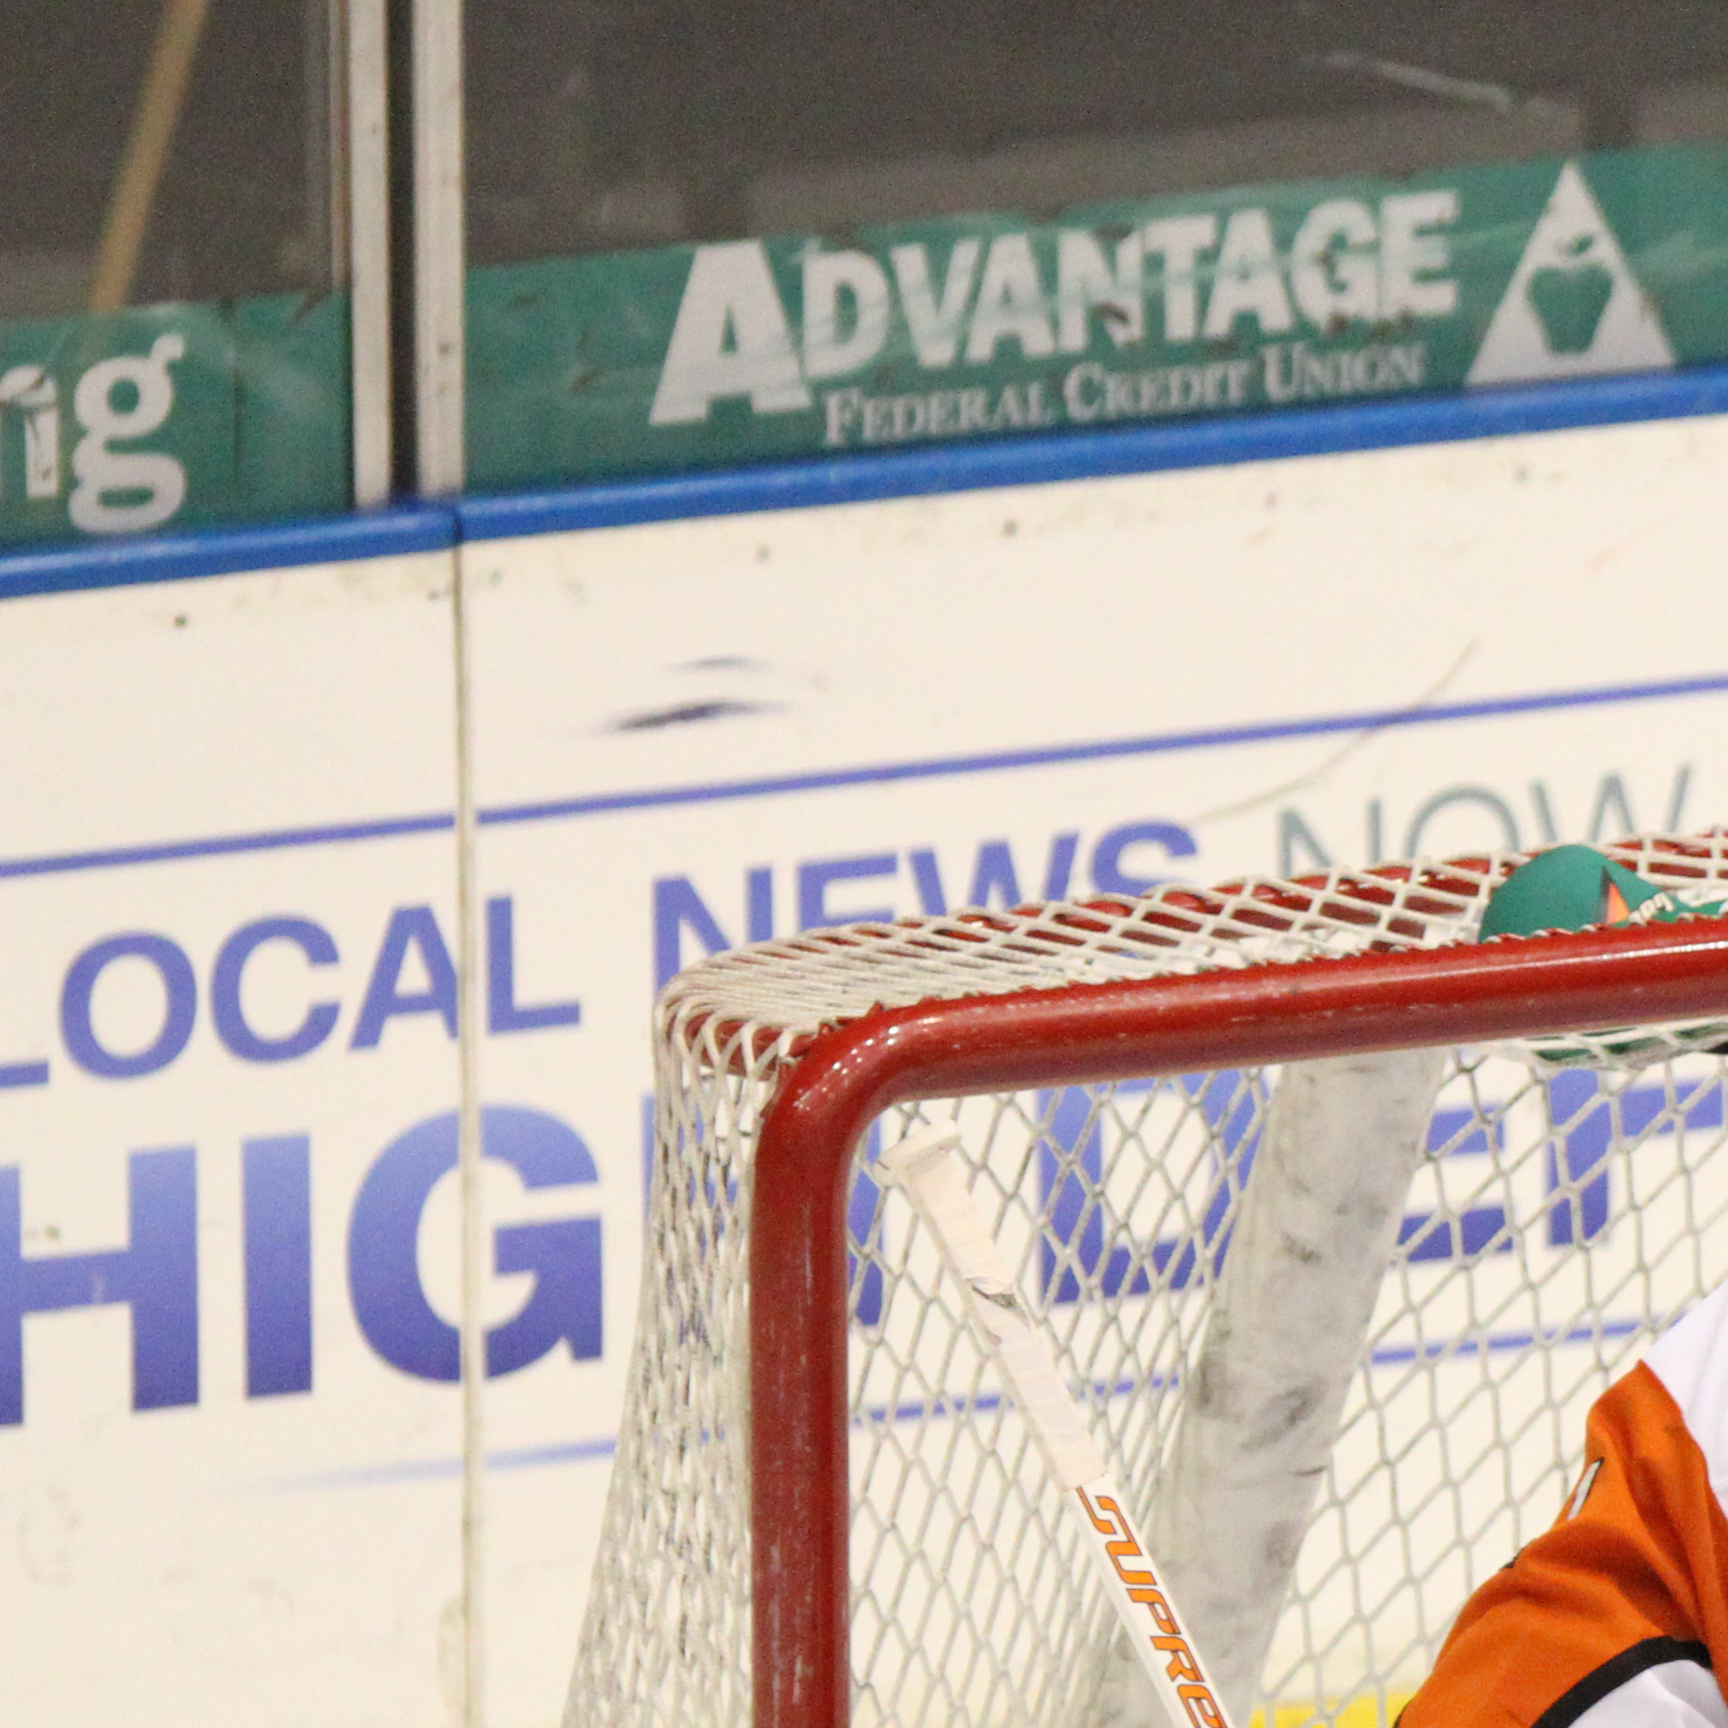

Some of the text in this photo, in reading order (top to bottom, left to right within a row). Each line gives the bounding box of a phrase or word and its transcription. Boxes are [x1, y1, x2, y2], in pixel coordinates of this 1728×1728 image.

[649, 190, 1460, 427] ADVANTAGE
[823, 342, 1426, 446] FEDERAL CREDIT UNION
